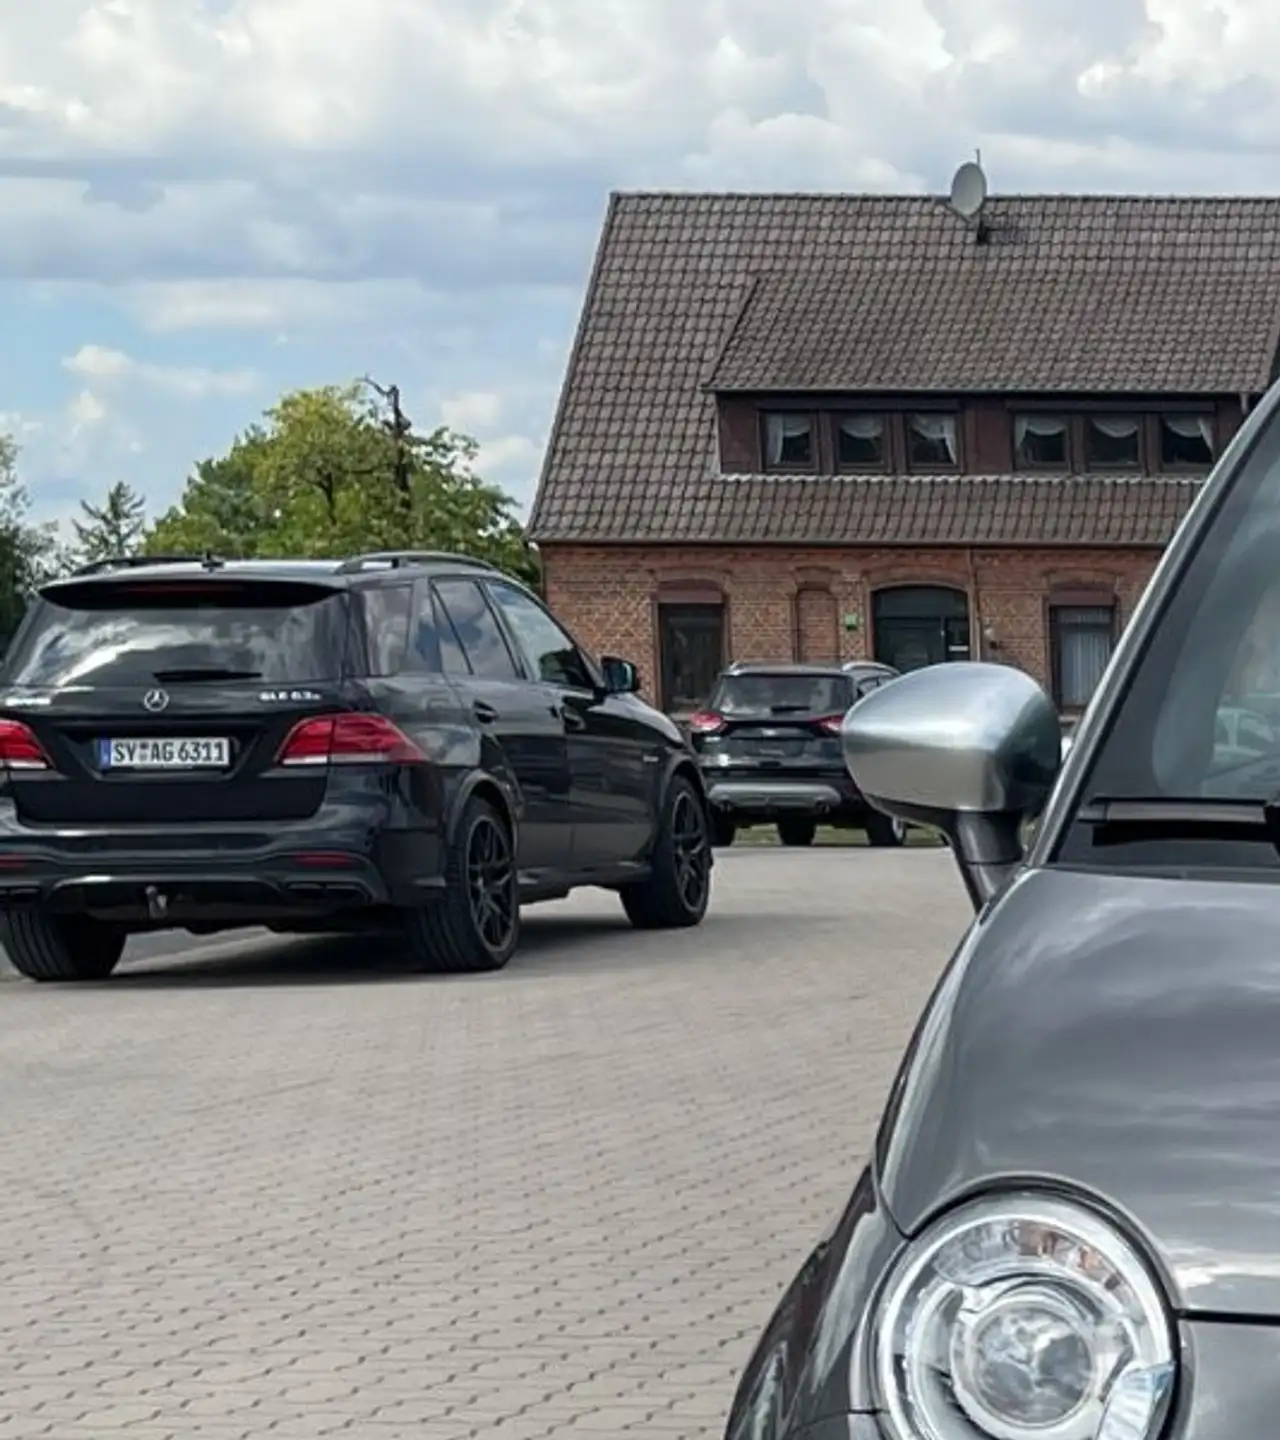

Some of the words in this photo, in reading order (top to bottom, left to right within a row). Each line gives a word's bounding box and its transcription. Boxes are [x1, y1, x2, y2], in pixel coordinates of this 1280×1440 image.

[114, 742, 136, 762] SY
[151, 742, 174, 762] AG
[178, 742, 225, 762] 6311
